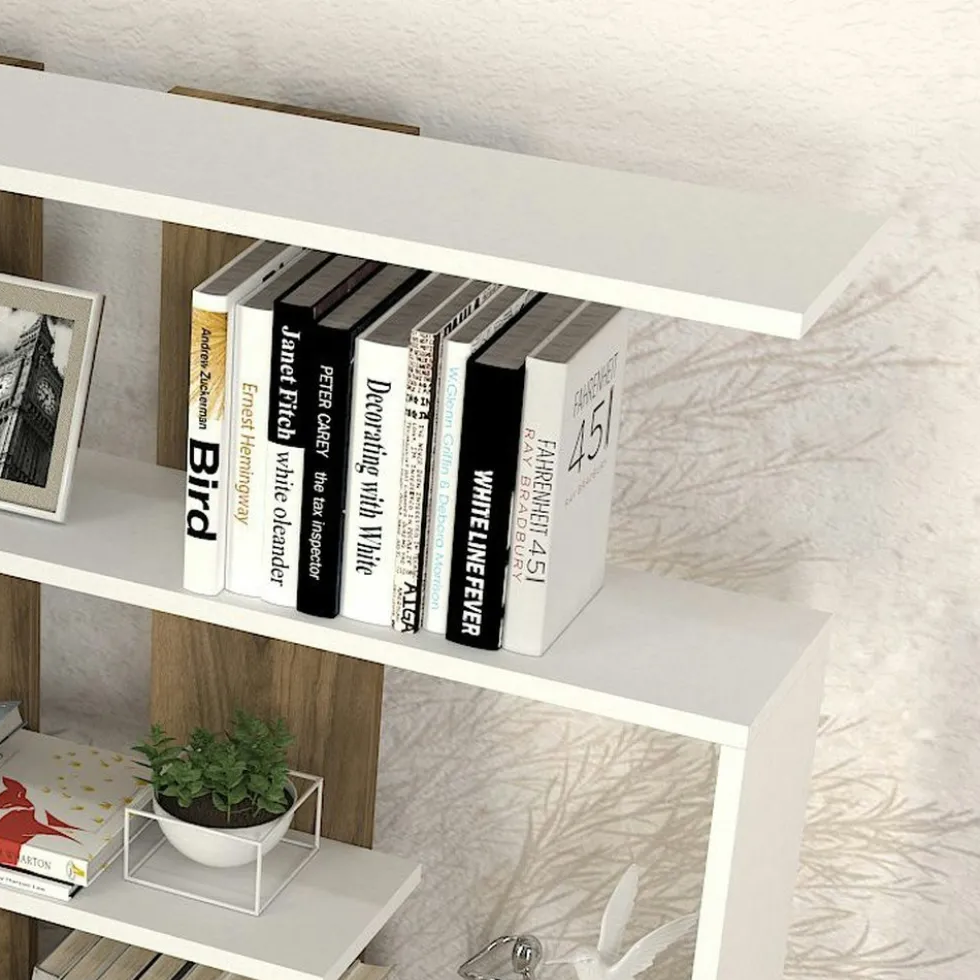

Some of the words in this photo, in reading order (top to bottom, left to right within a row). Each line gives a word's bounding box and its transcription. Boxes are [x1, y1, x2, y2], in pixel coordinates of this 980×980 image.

[200, 327, 211, 369] Andrew
[279, 325, 301, 385] Janet
[198, 370, 212, 430] Zuckerman
[242, 383, 258, 432] Ernest
[319, 365, 334, 410] PETER
[573, 352, 619, 418] FAHRENHEIT
[277, 386, 299, 440] Fitch
[316, 413, 331, 458] CAREY
[355, 377, 391, 477] Decorating
[568, 384, 615, 473] 451
[440, 433, 454, 475] Griffin
[522, 427, 536, 467] RAY
[186, 438, 220, 541] Bird
[234, 434, 257, 525] Hemingway
[273, 450, 295, 503] white
[314, 472, 328, 489] the
[359, 482, 384, 518] with
[529, 439, 557, 537] FAHRENHEIT
[312, 492, 325, 516] tax
[436, 494, 449, 549] Debora
[512, 475, 533, 584] BRADBURY
[270, 505, 293, 587] oleander
[309, 519, 323, 581] inspector
[356, 526, 382, 575] White
[525, 539, 547, 583] 451
[401, 581, 417, 633] AIGA
[431, 552, 445, 610] Morrison
[461, 576, 484, 637] FEVER
